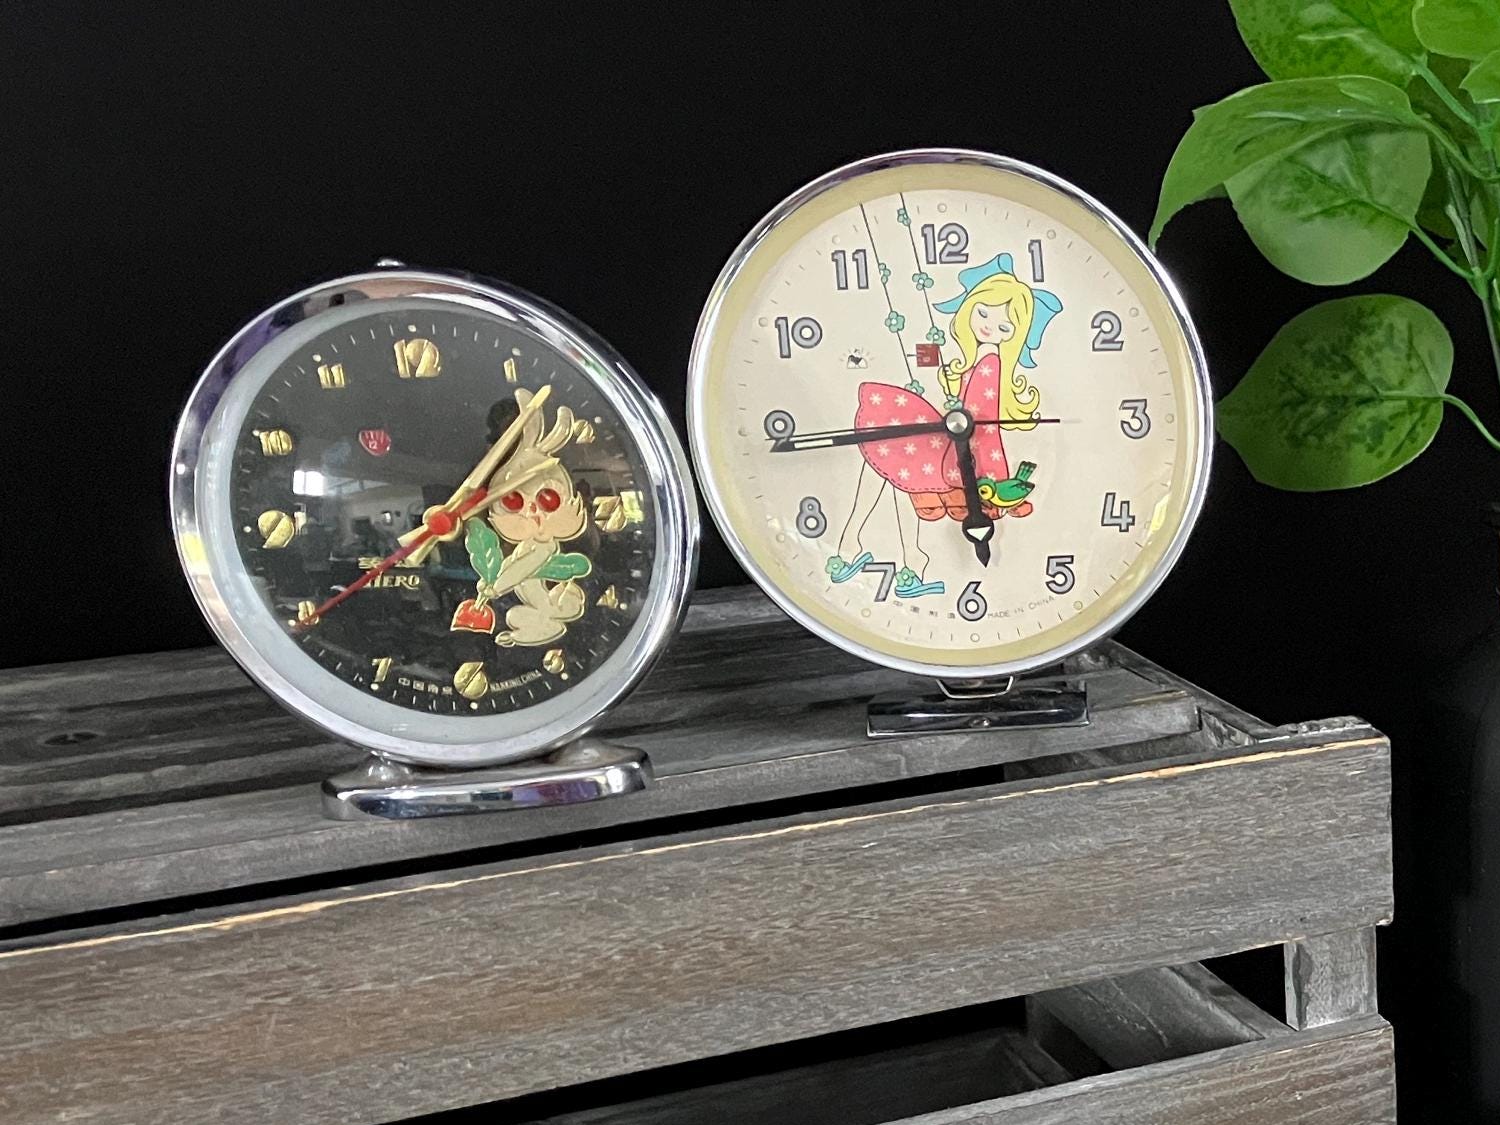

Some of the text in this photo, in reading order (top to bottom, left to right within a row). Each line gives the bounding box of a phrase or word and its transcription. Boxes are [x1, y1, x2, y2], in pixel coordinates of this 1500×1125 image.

[921, 223, 970, 264] 12
[1028, 239, 1044, 282] 1
[831, 249, 869, 290] 11
[774, 317, 823, 358] 10
[1091, 311, 1124, 352] 2
[318, 364, 346, 388] 11
[394, 338, 441, 378] 12
[503, 359, 516, 382] 1
[573, 421, 595, 443] 2
[1119, 399, 1151, 439] 3
[260, 430, 292, 456] 10
[258, 510, 295, 548] 9
[594, 496, 627, 532] 3
[795, 496, 828, 538] 8
[1101, 493, 1135, 532] 4
[363, 571, 421, 590] HERO
[860, 562, 897, 602] 7
[1045, 555, 1076, 593] 5
[597, 587, 618, 609] 4
[957, 581, 988, 621] 6
[987, 594, 1055, 618] MADE IN CHINA
[372, 657, 392, 683] 7
[453, 661, 487, 699] 6
[544, 649, 565, 674] 5
